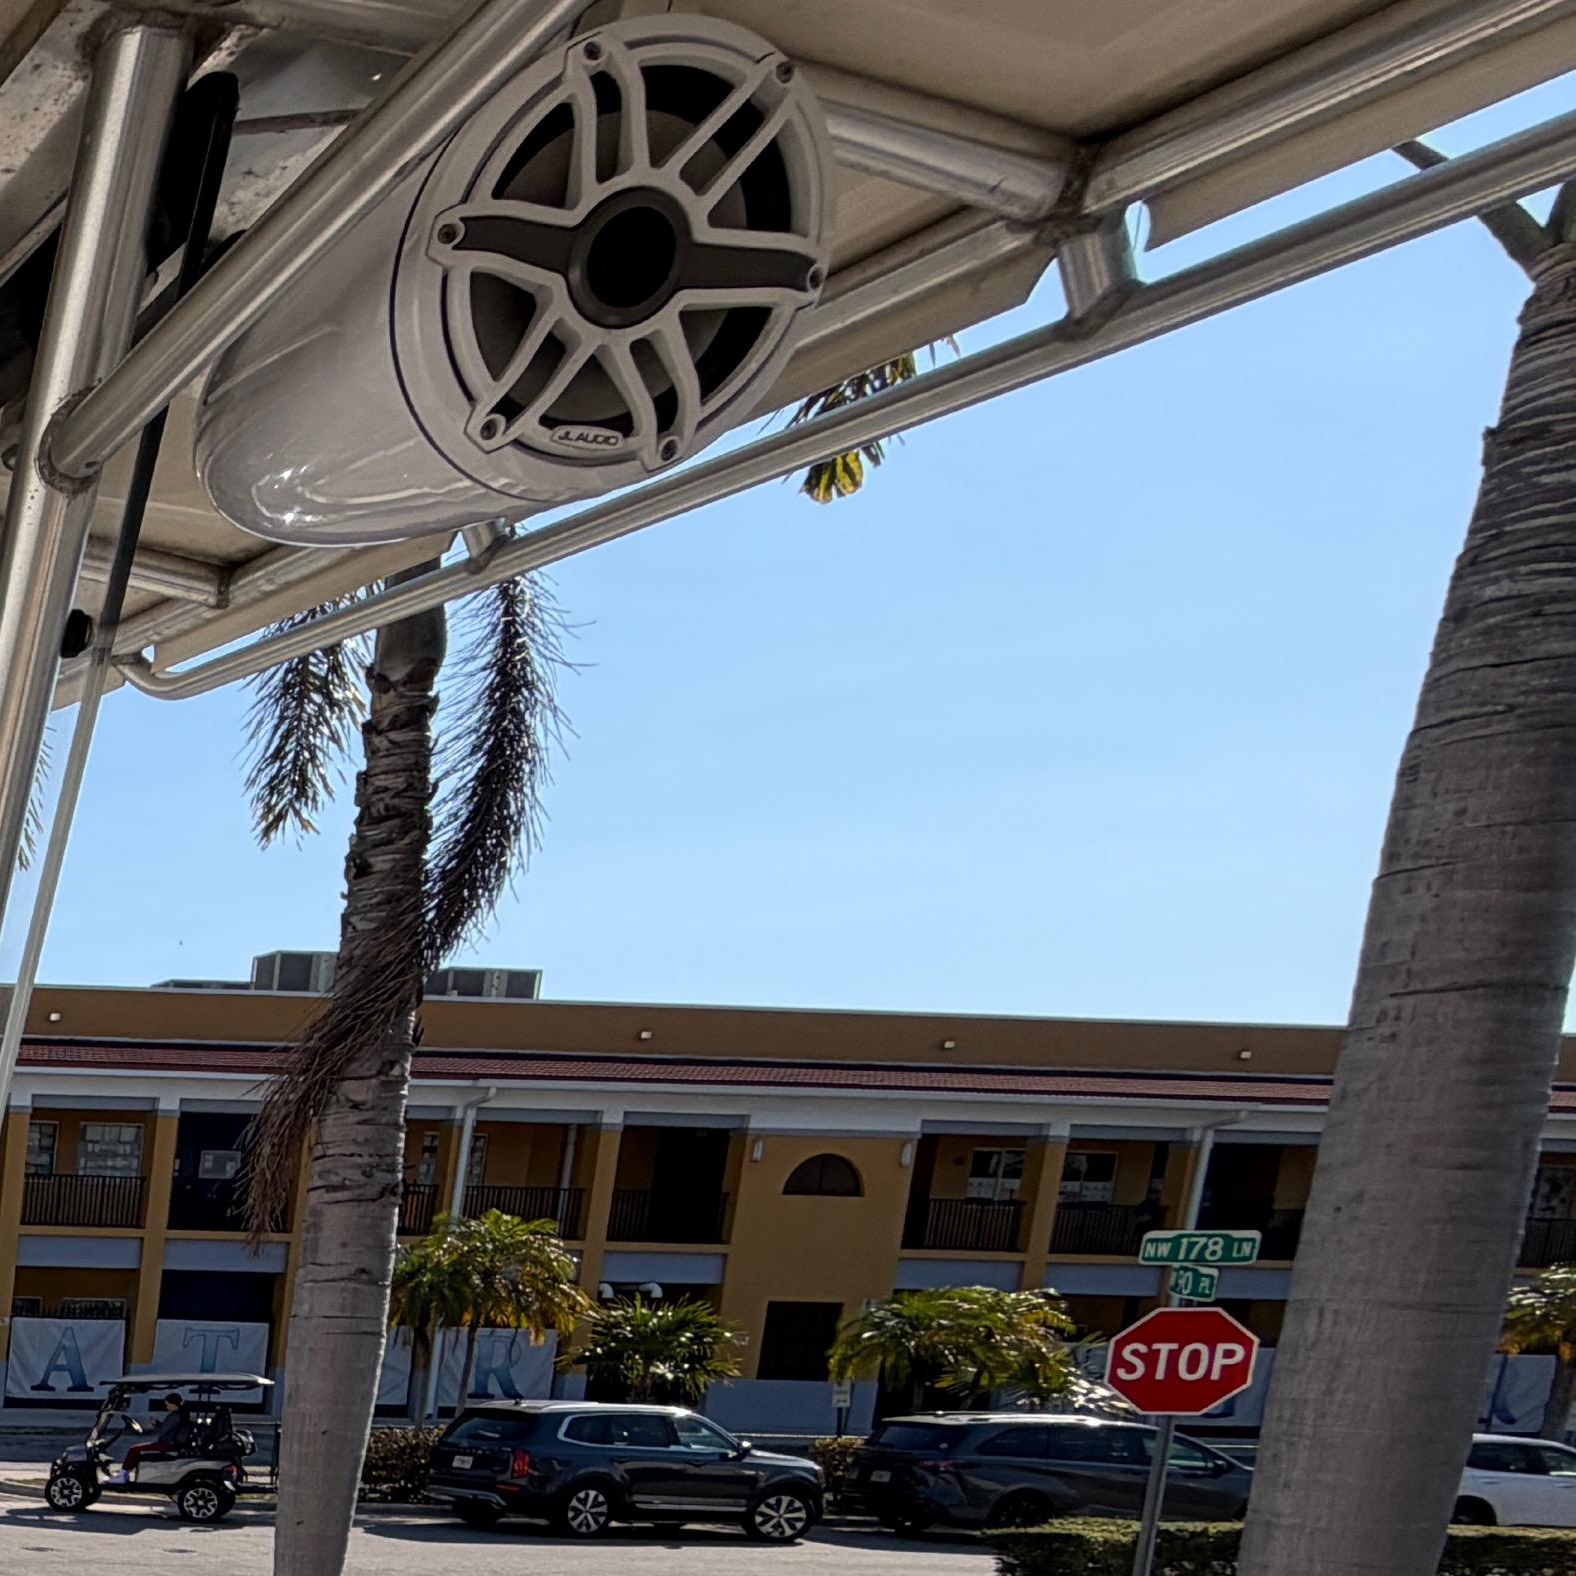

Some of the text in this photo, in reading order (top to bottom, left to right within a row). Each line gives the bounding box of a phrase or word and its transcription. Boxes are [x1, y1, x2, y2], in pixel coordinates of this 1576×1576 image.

[575, 432, 619, 446] AUDIO
[1144, 1236, 1253, 1261] NW 178 LN
[30, 1326, 95, 1392] A
[182, 1327, 239, 1395] T
[1117, 1341, 1245, 1381] STOP
